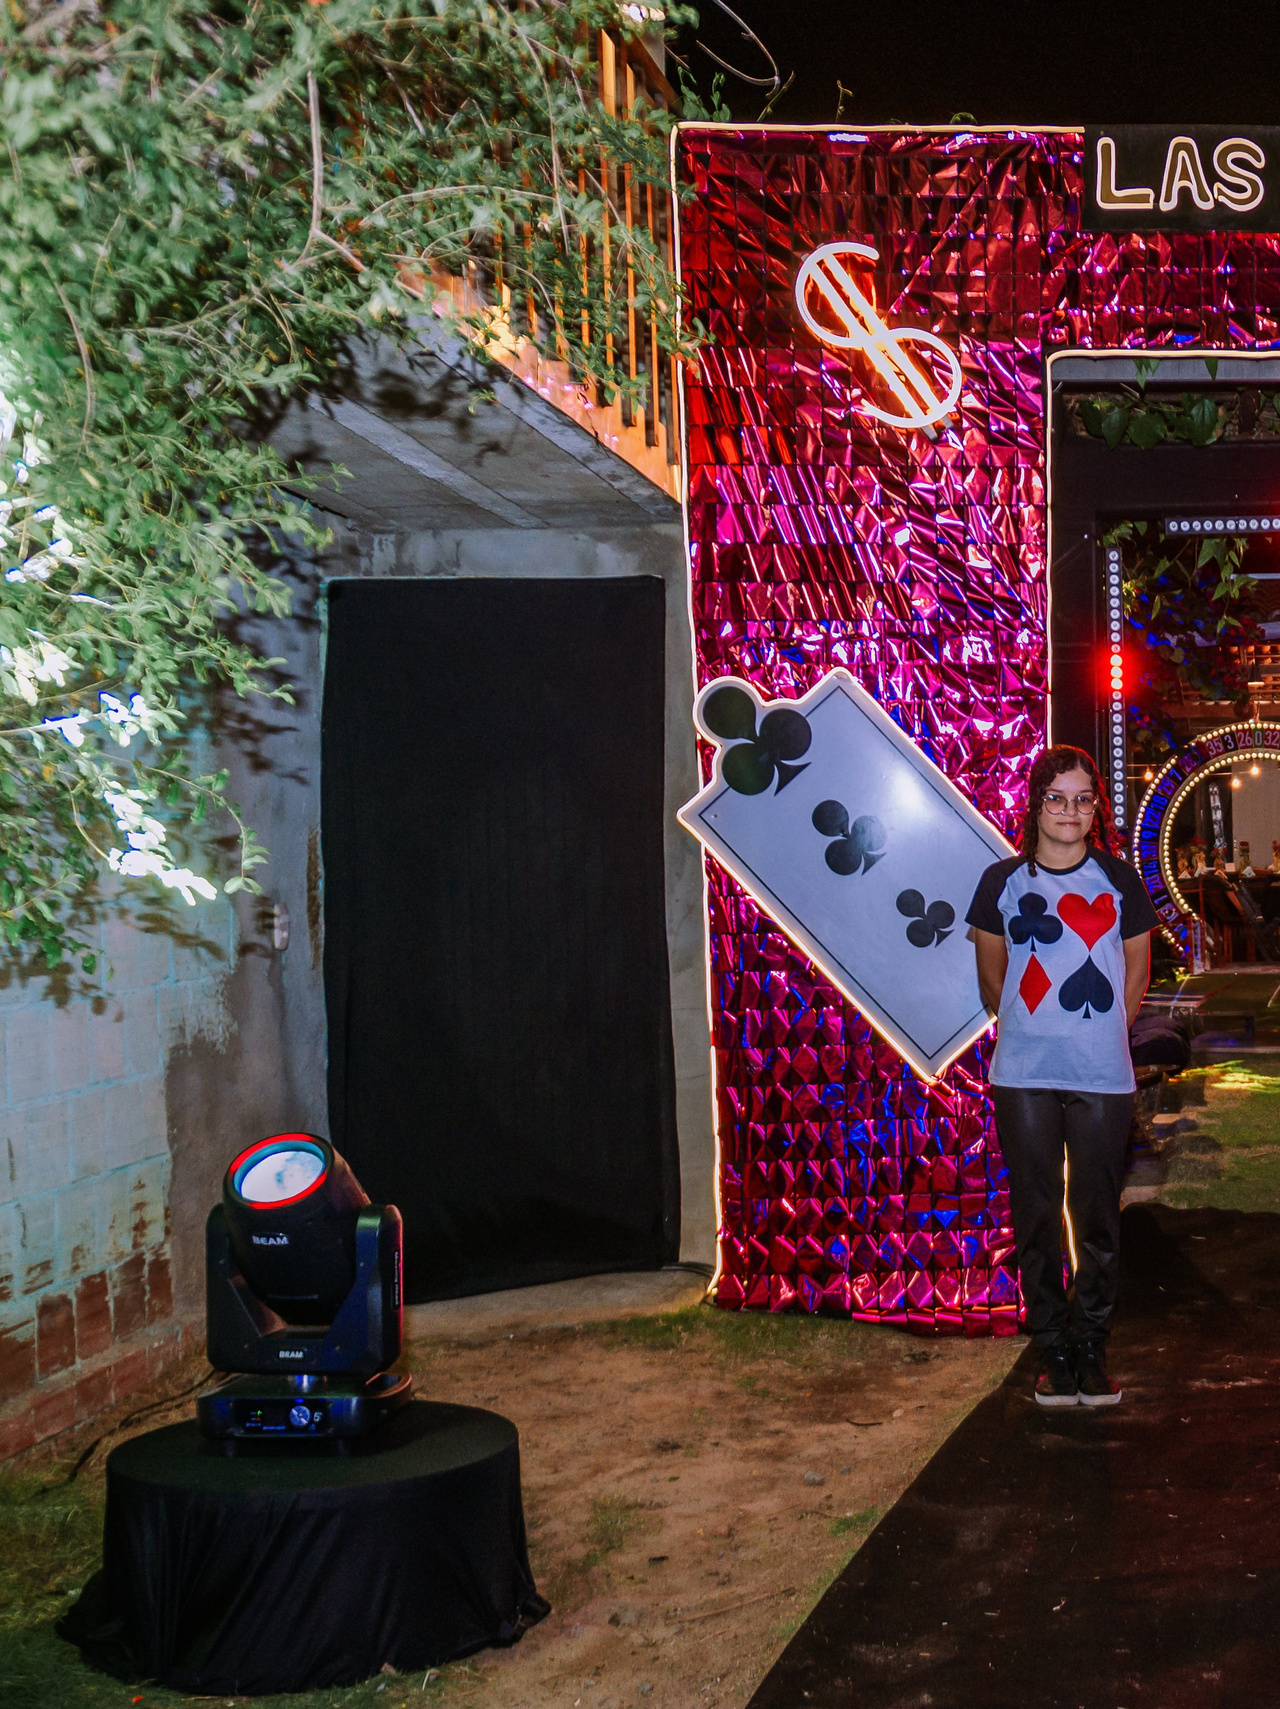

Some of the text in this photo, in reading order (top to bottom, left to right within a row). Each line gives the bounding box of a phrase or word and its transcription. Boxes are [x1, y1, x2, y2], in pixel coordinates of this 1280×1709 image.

[1096, 136, 1265, 211] LAS
[1206, 737, 1224, 755] 35
[1224, 734, 1235, 750] 3
[1237, 731, 1253, 747] 26
[1254, 730, 1263, 746] 0
[1264, 730, 1280, 746] 32
[1168, 767, 1183, 781] 7
[1157, 777, 1175, 796] 29
[1150, 794, 1168, 811] 18
[1141, 830, 1158, 839] 9
[1141, 844, 1157, 859] 31
[1143, 860, 1159, 877] 14
[1145, 874, 1164, 893] 20
[252, 1235, 289, 1246] BEAM
[279, 1350, 304, 1359] BEAM
